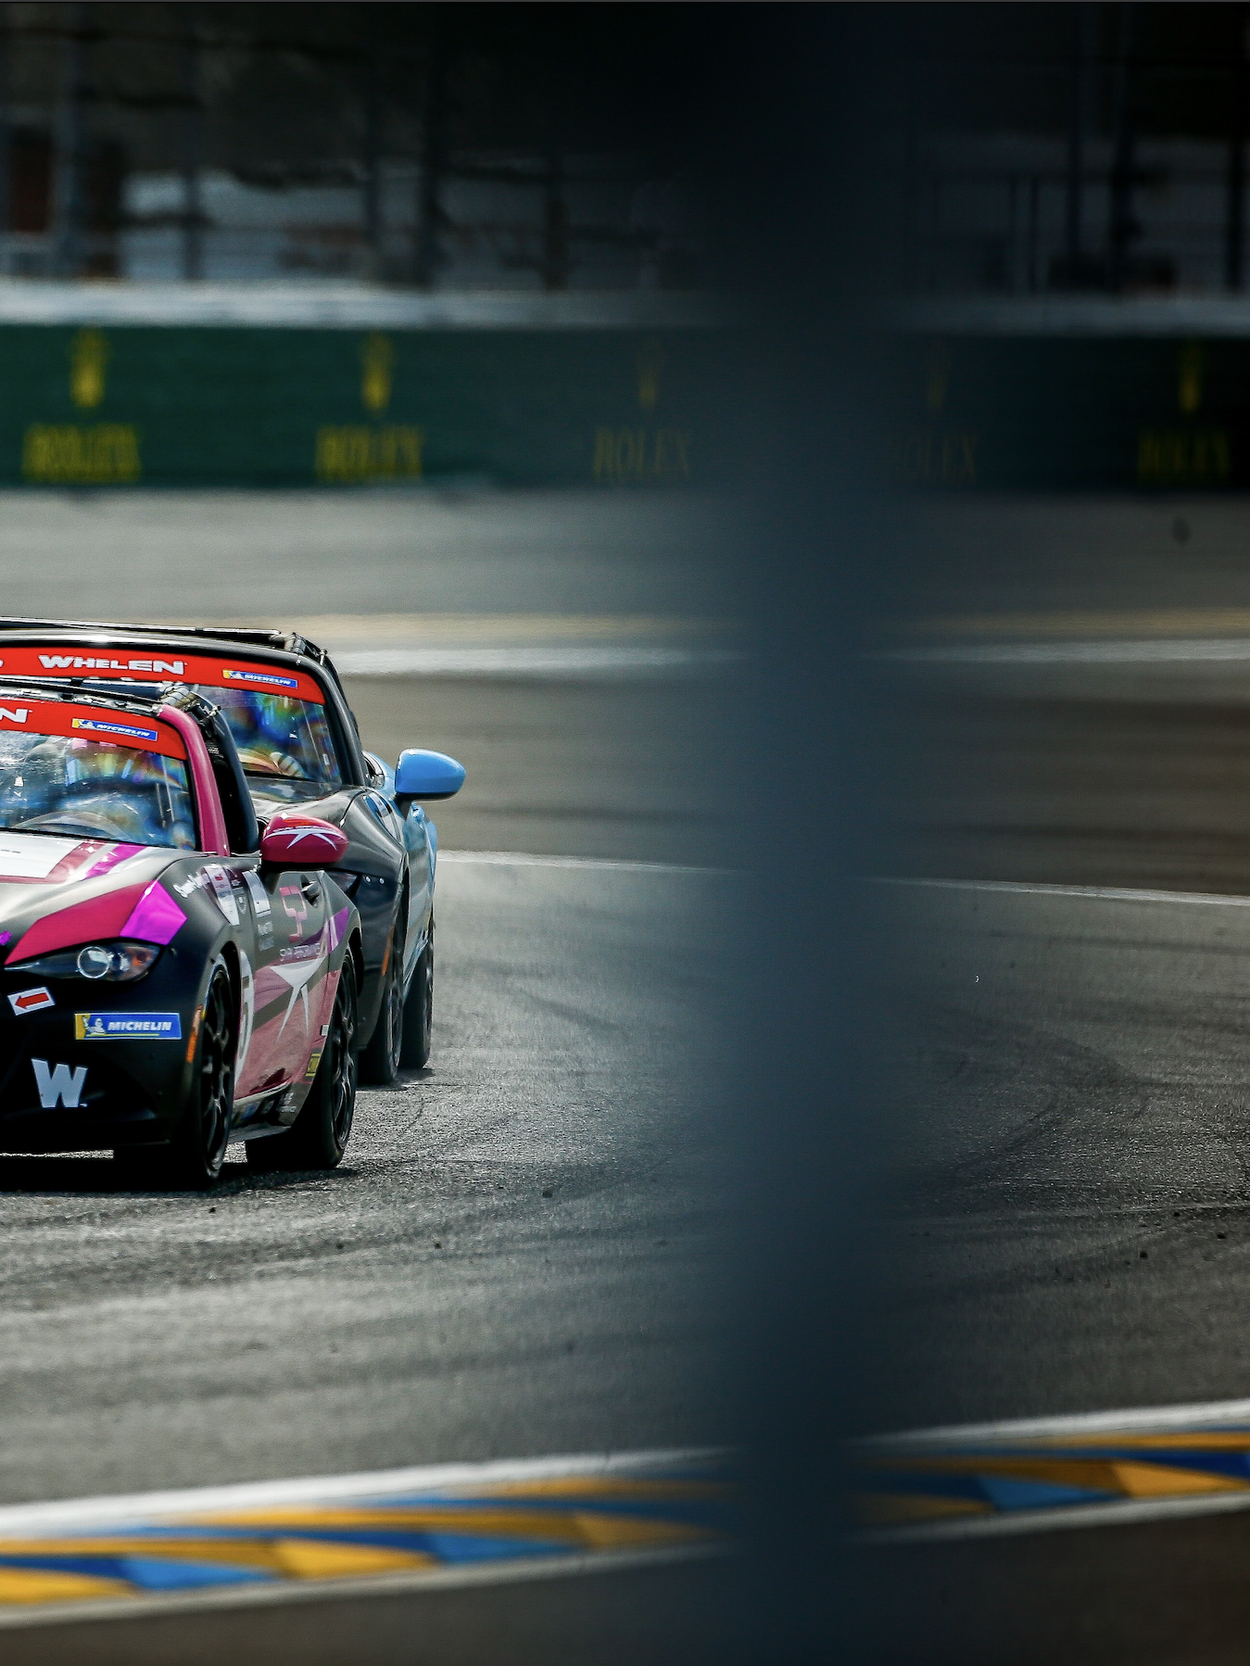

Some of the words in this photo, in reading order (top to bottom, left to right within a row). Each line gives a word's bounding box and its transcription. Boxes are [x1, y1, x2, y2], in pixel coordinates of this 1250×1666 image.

[38, 655, 184, 675] WHELEN
[244, 674, 291, 685] MICHELIN
[96, 723, 151, 737] MICHELIN
[108, 1021, 172, 1031] MICHELIN
[31, 1058, 88, 1108] W
